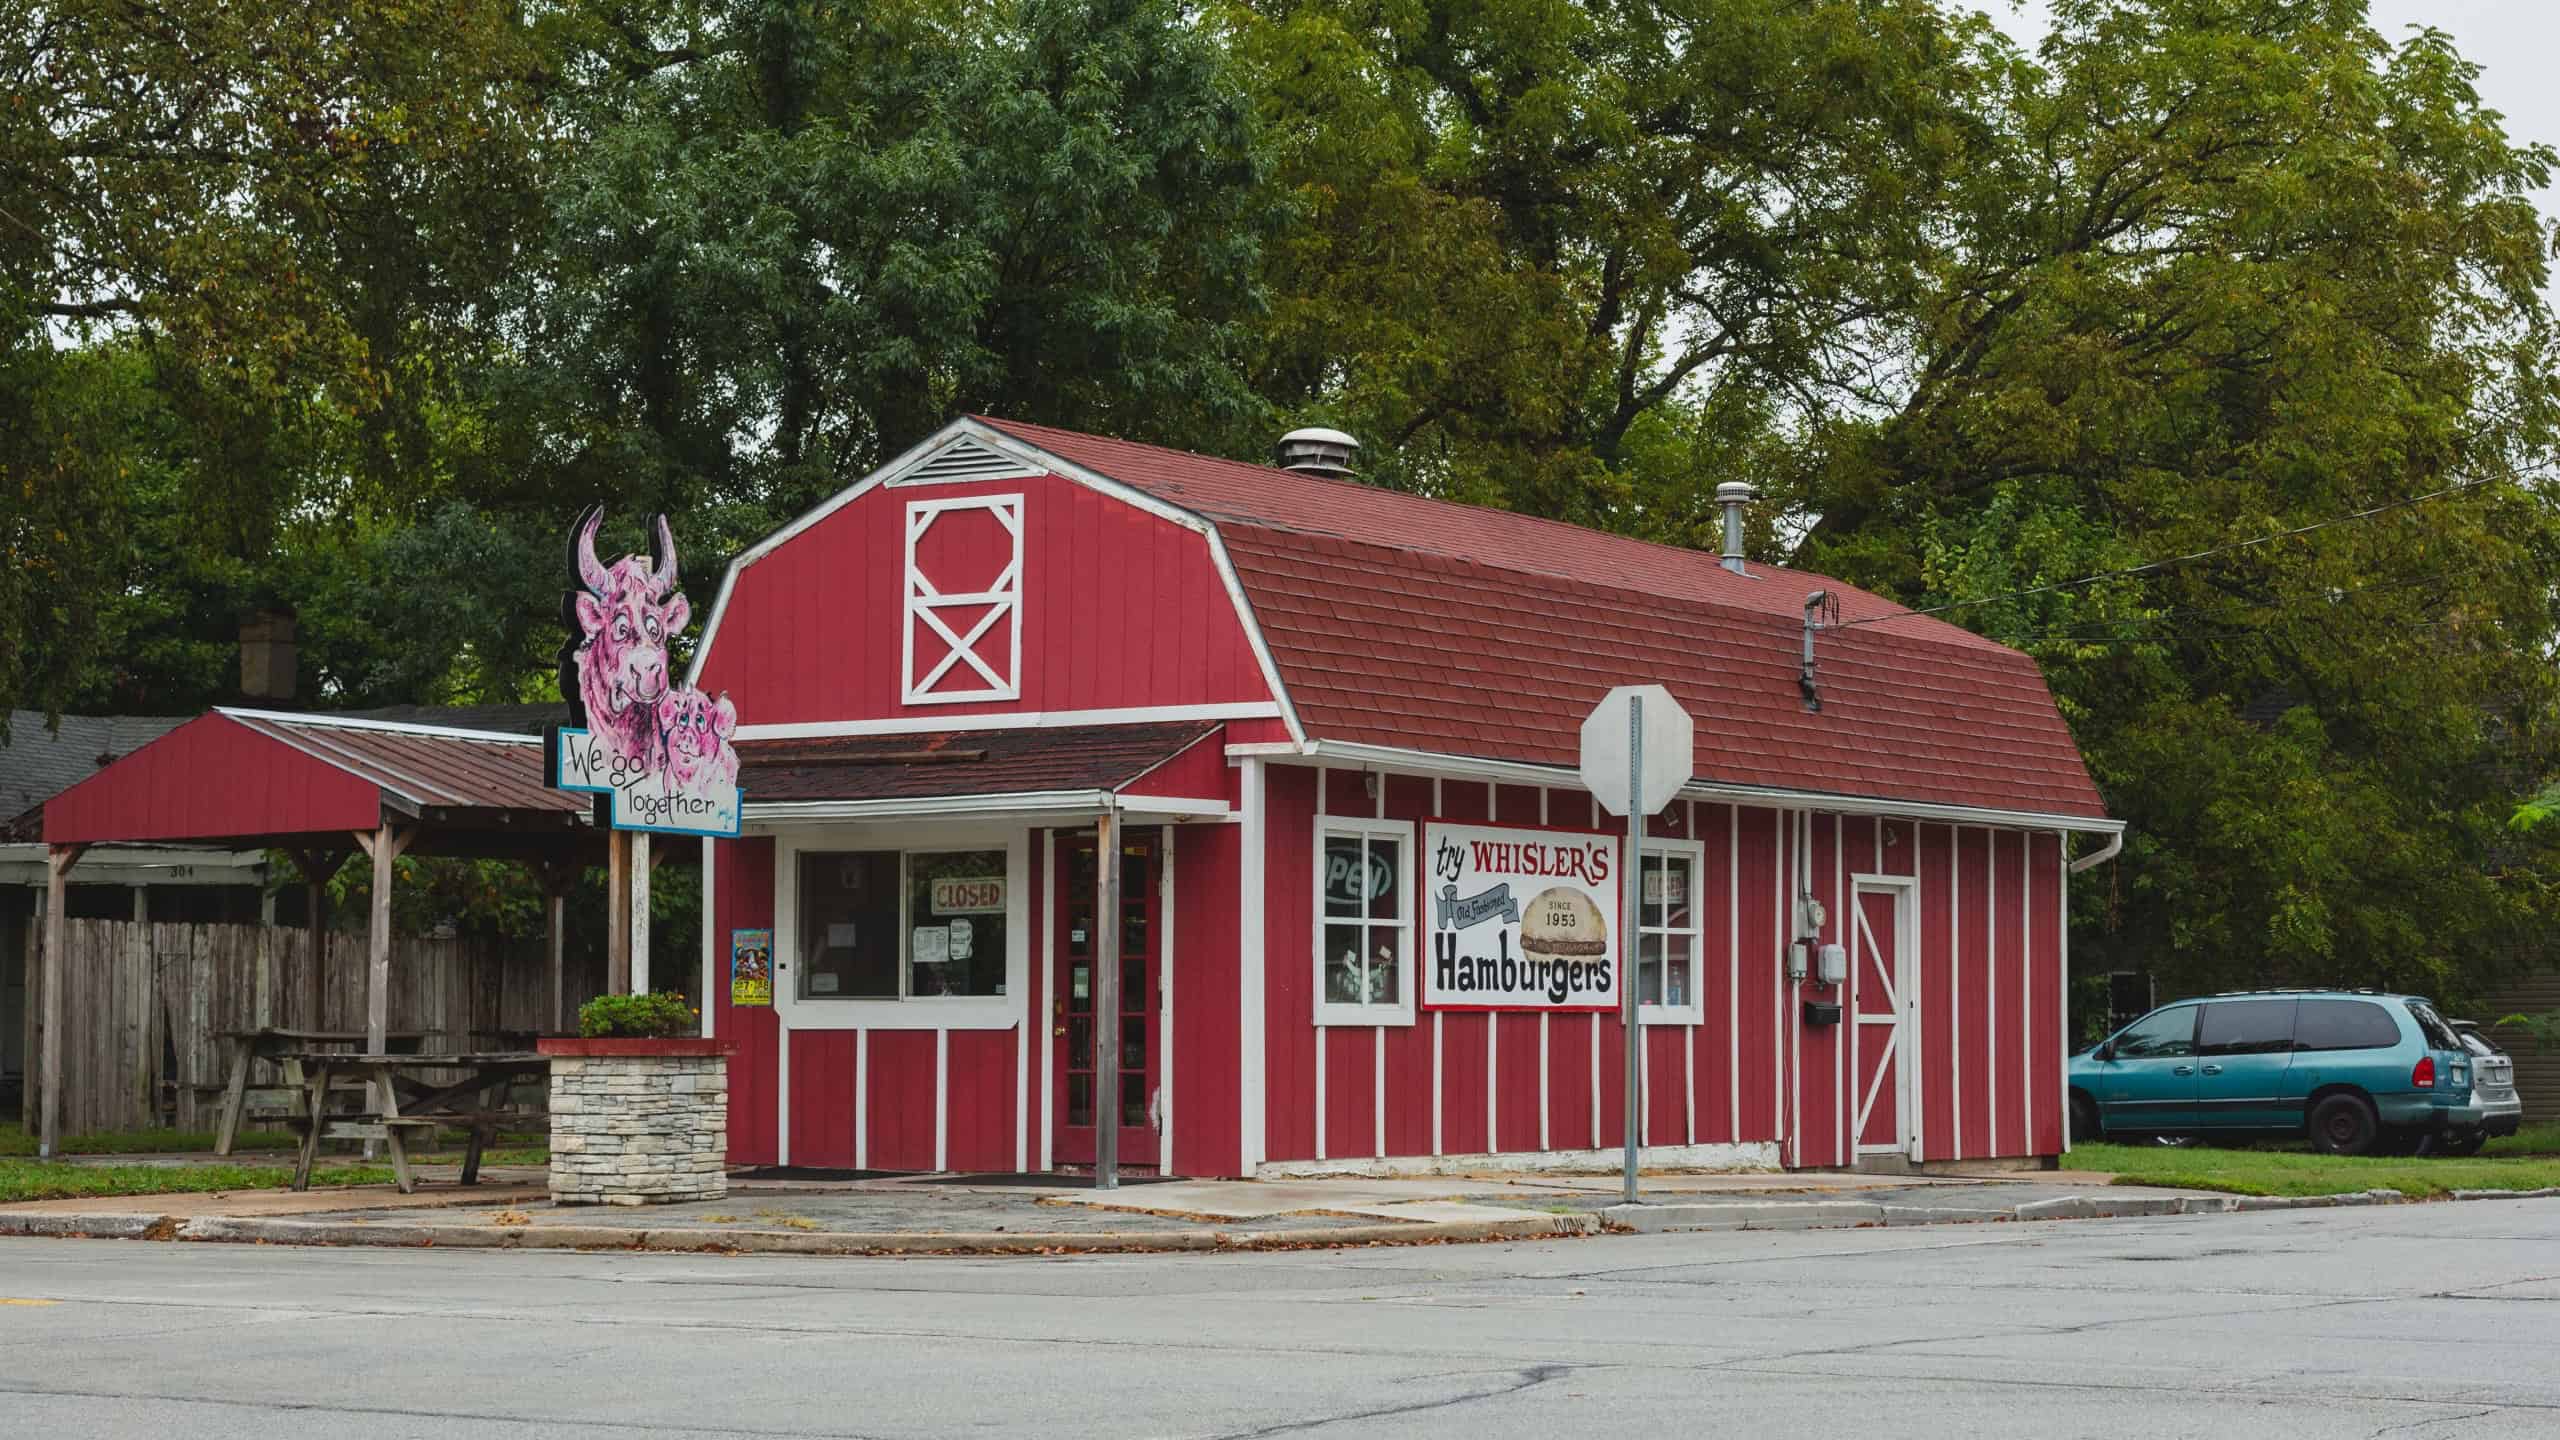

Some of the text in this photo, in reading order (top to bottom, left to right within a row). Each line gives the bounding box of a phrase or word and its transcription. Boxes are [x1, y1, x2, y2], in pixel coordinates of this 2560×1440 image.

[566, 734, 644, 787] We go
[623, 774, 715, 824] Together
[1325, 855, 1384, 900] PEN
[1436, 834, 1609, 886] try WHISLER'S
[937, 883, 1000, 908] CLOSED
[1457, 905, 1470, 920] Old
[1549, 901, 1571, 910] SINCE
[1546, 912, 1576, 927] 1953
[1435, 929, 1611, 1004] Hamburgers
